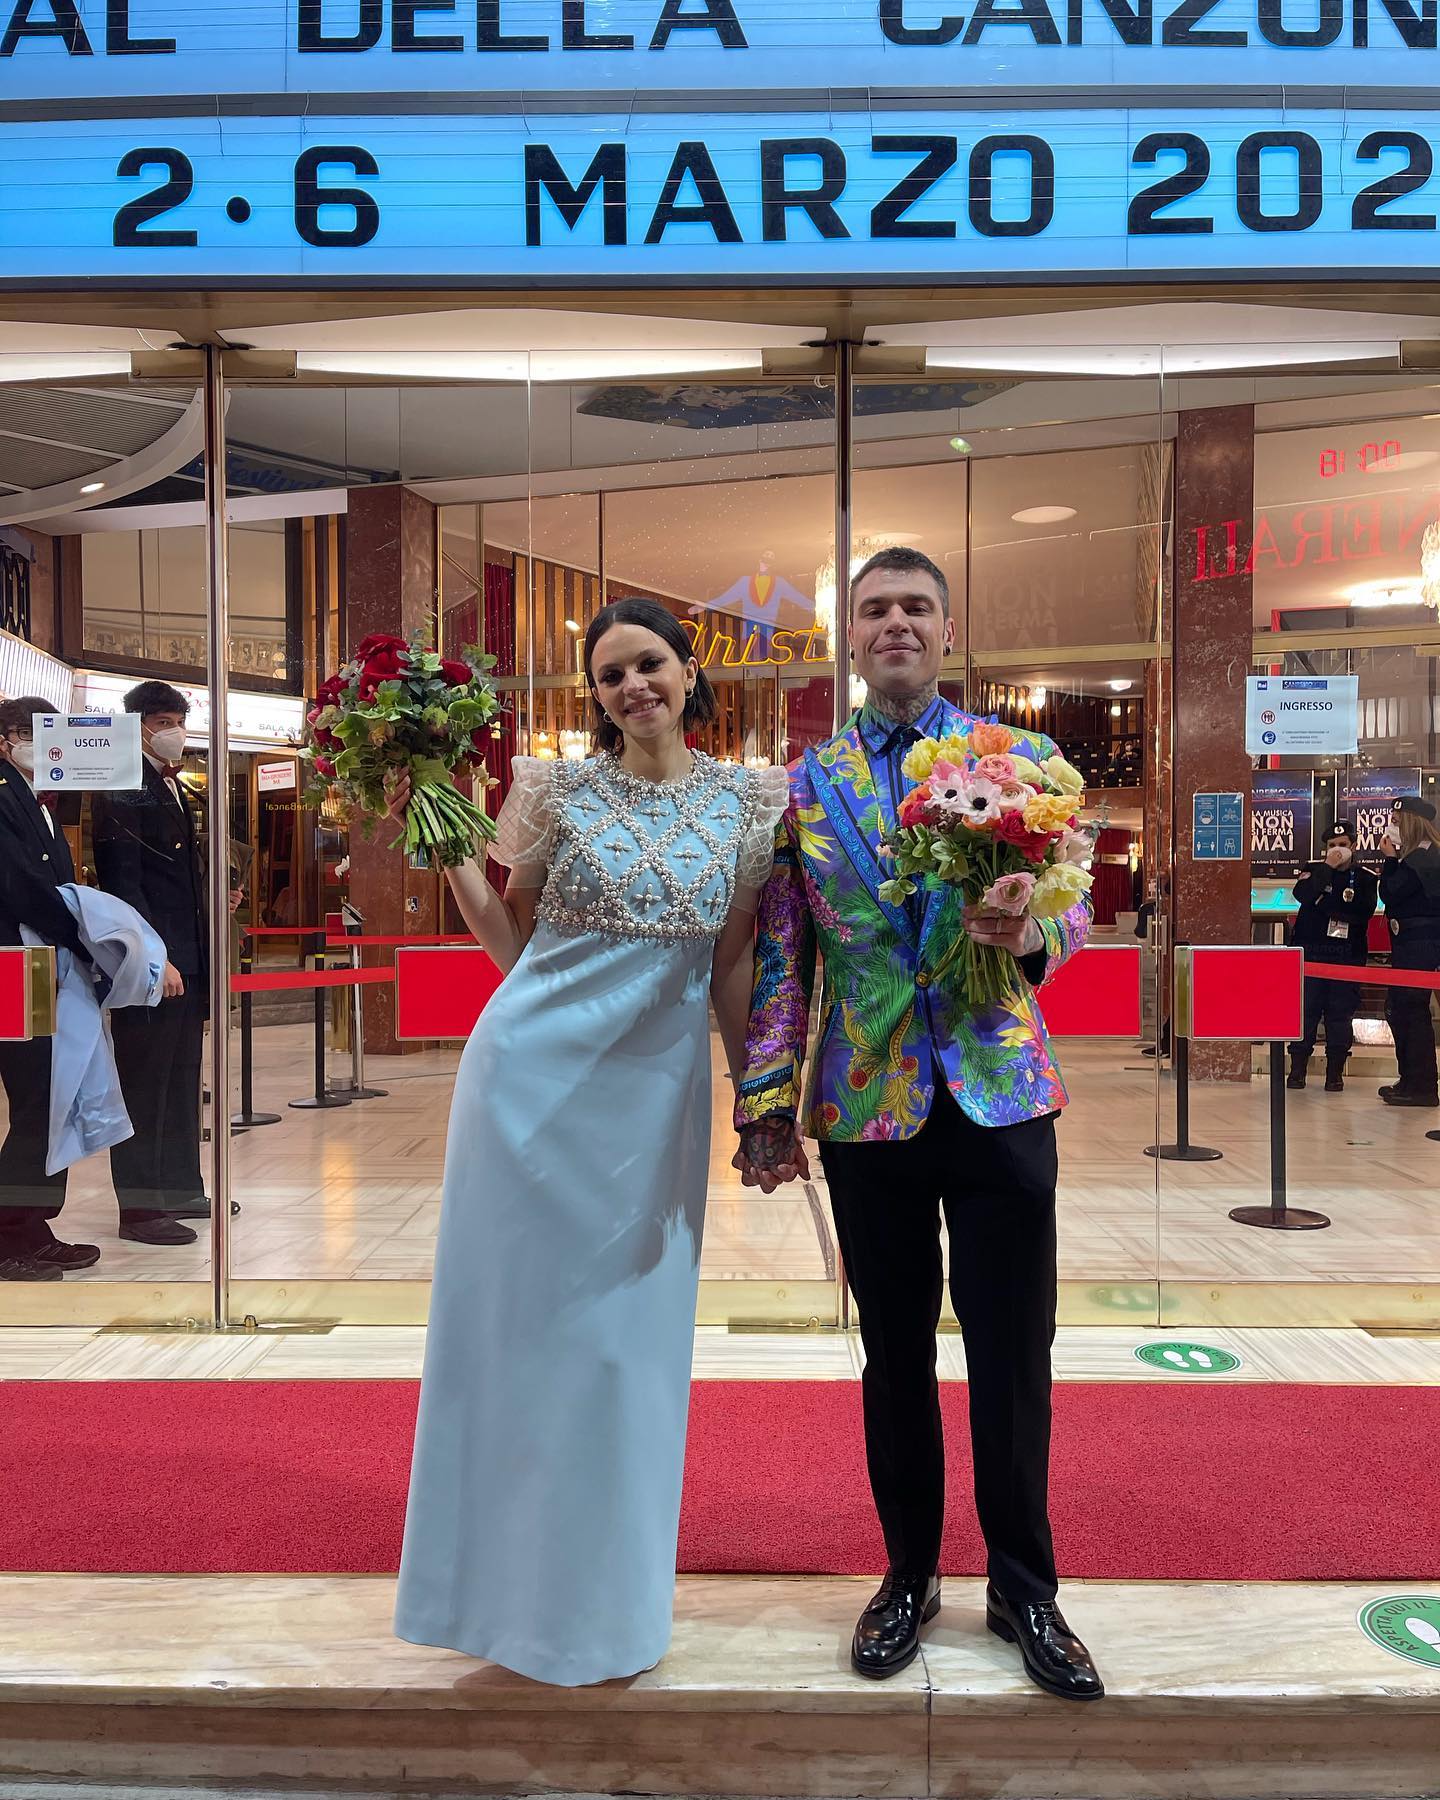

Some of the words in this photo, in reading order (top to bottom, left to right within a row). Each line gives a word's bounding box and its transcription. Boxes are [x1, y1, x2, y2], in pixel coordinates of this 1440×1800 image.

[524, 134, 1055, 246] MARZO
[1280, 701, 1333, 711] INGRESSO
[259, 724, 285, 733] SALA
[74, 738, 111, 748] USCITA
[1251, 816, 1294, 829] NON
[1251, 828, 1260, 836] SI
[1261, 828, 1294, 836] FERMA
[1356, 827, 1365, 835] SI
[1367, 827, 1385, 835] FER
[1251, 834, 1294, 851] MAI
[1384, 1602, 1412, 1616] QUI
[1413, 1601, 1432, 1609] IL
[1376, 1615, 1420, 1651] ASPETTA
